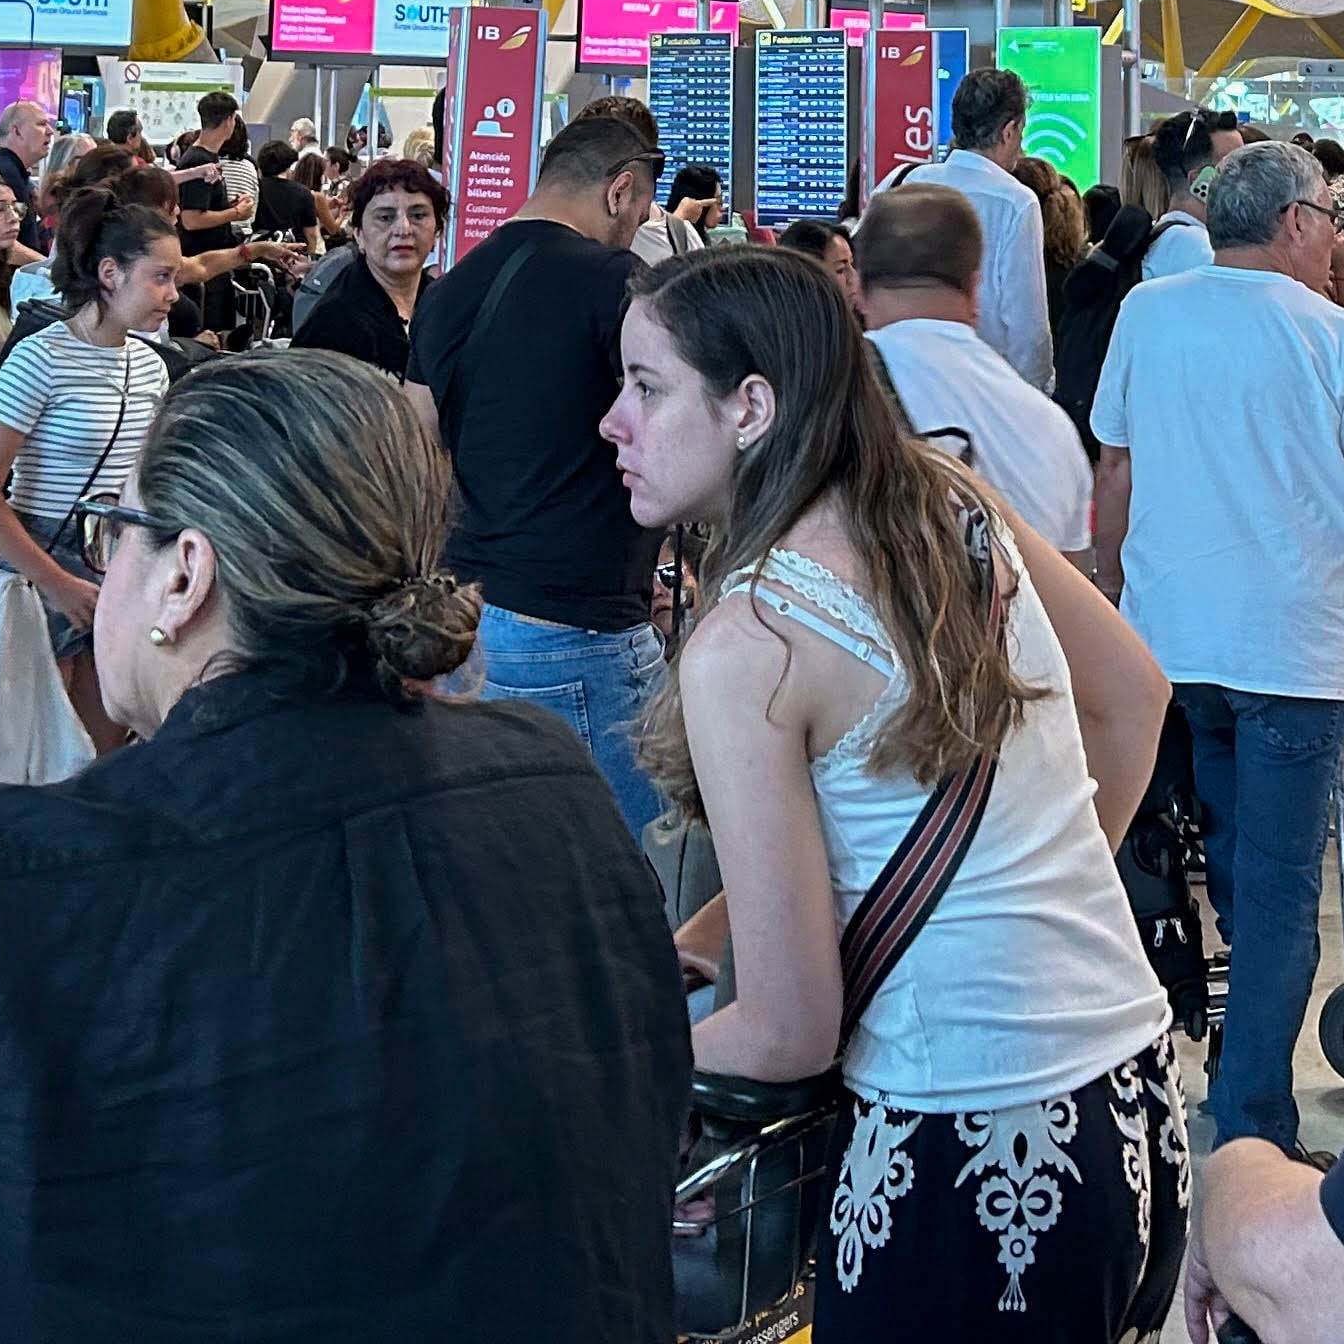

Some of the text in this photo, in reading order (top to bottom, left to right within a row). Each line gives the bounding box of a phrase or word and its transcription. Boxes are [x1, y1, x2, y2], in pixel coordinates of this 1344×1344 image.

[477, 26, 500, 41] IB
[881, 46, 900, 59] IB
[469, 151, 510, 162] Atención
[468, 164, 511, 174] al cliente
[468, 178, 514, 187] y venta de
[467, 188, 502, 199] billetes
[466, 203, 507, 215] Customer
[465, 217, 495, 226] service
[464, 228, 489, 239] ticket
